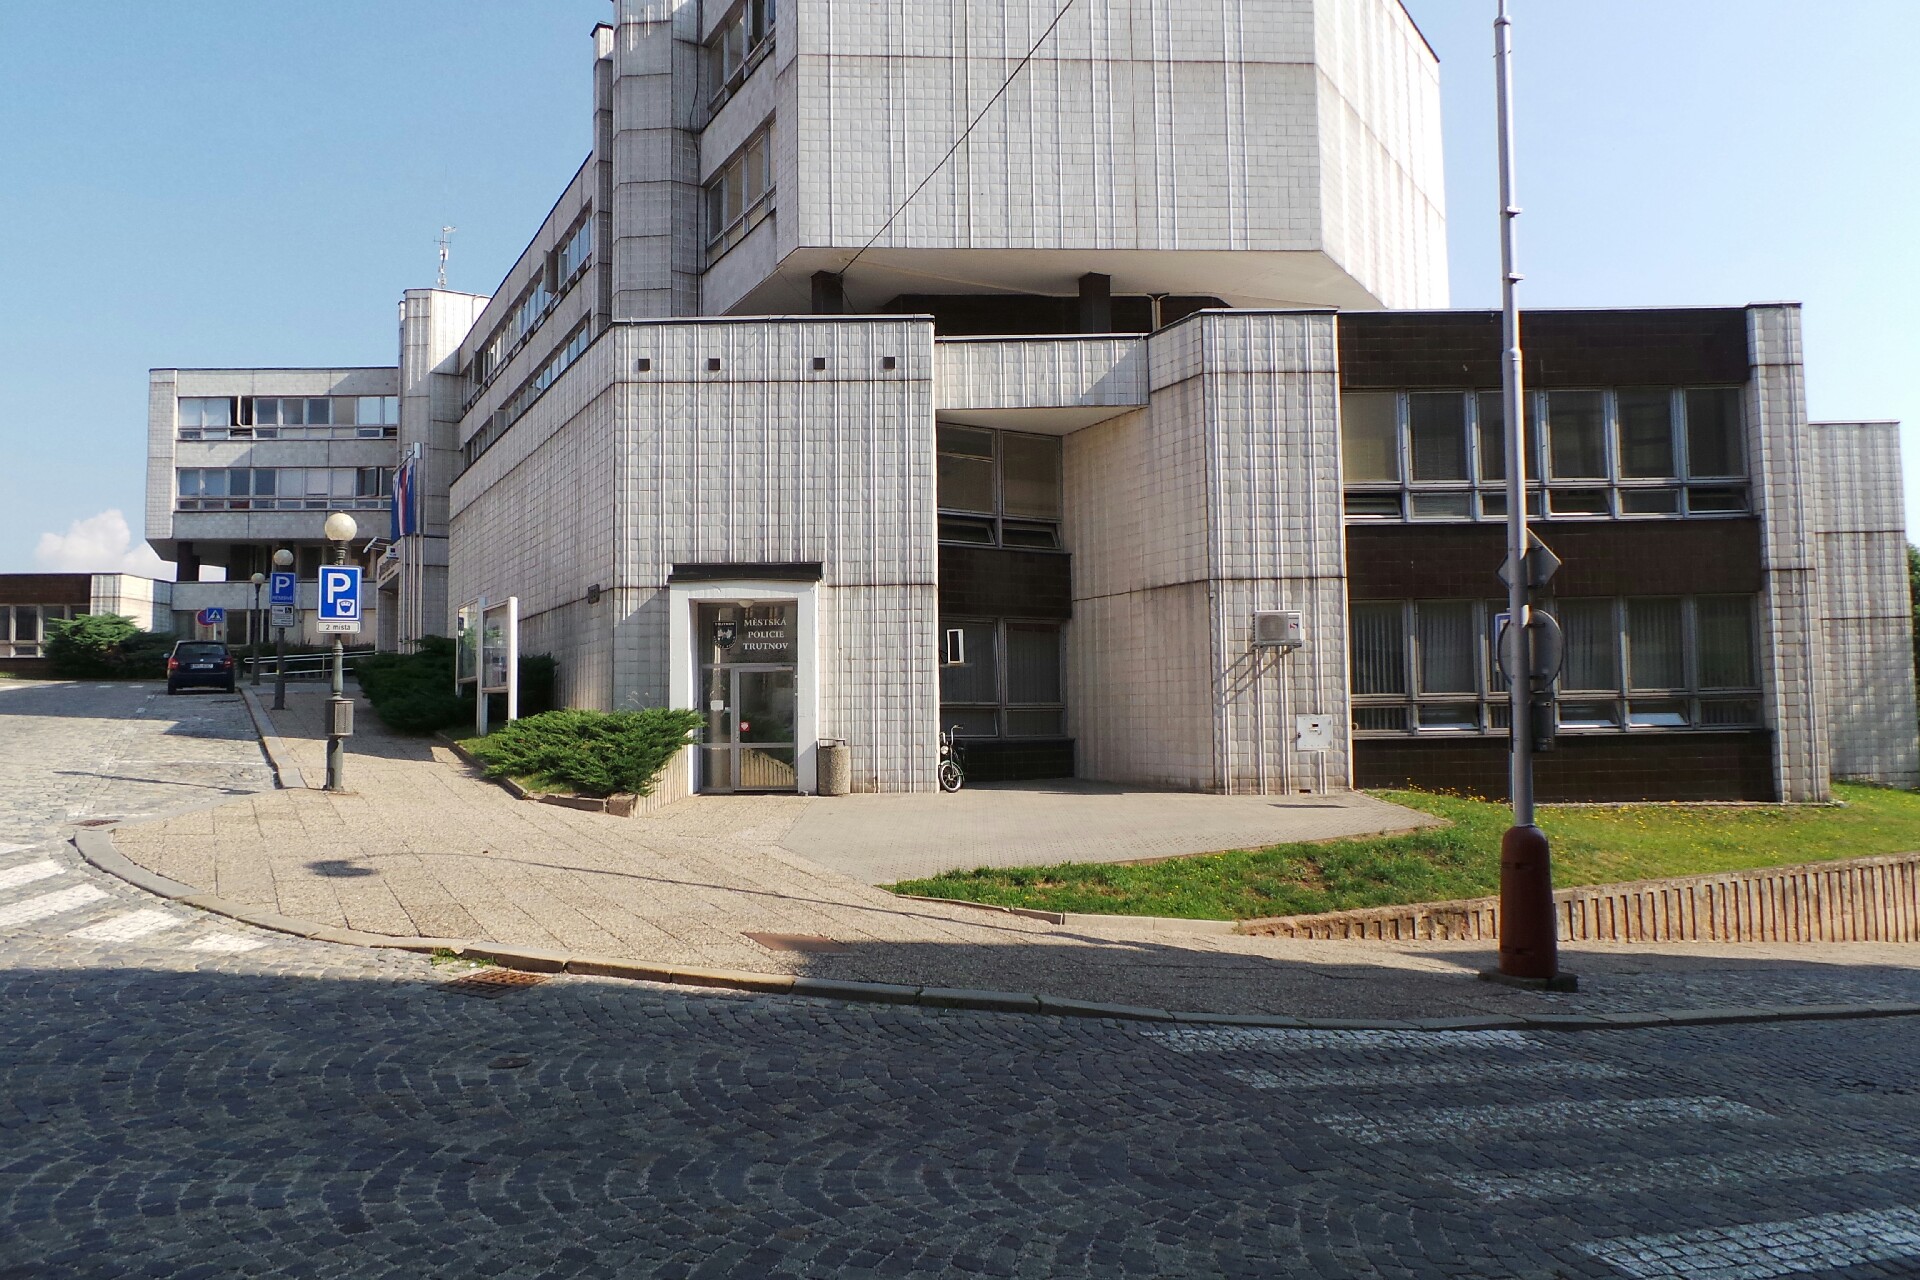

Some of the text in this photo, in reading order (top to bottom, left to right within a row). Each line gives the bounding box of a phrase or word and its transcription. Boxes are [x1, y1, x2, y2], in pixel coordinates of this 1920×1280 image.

[275, 576, 290, 594] P
[327, 572, 351, 603] P
[743, 642, 788, 650] TRUTNOV
